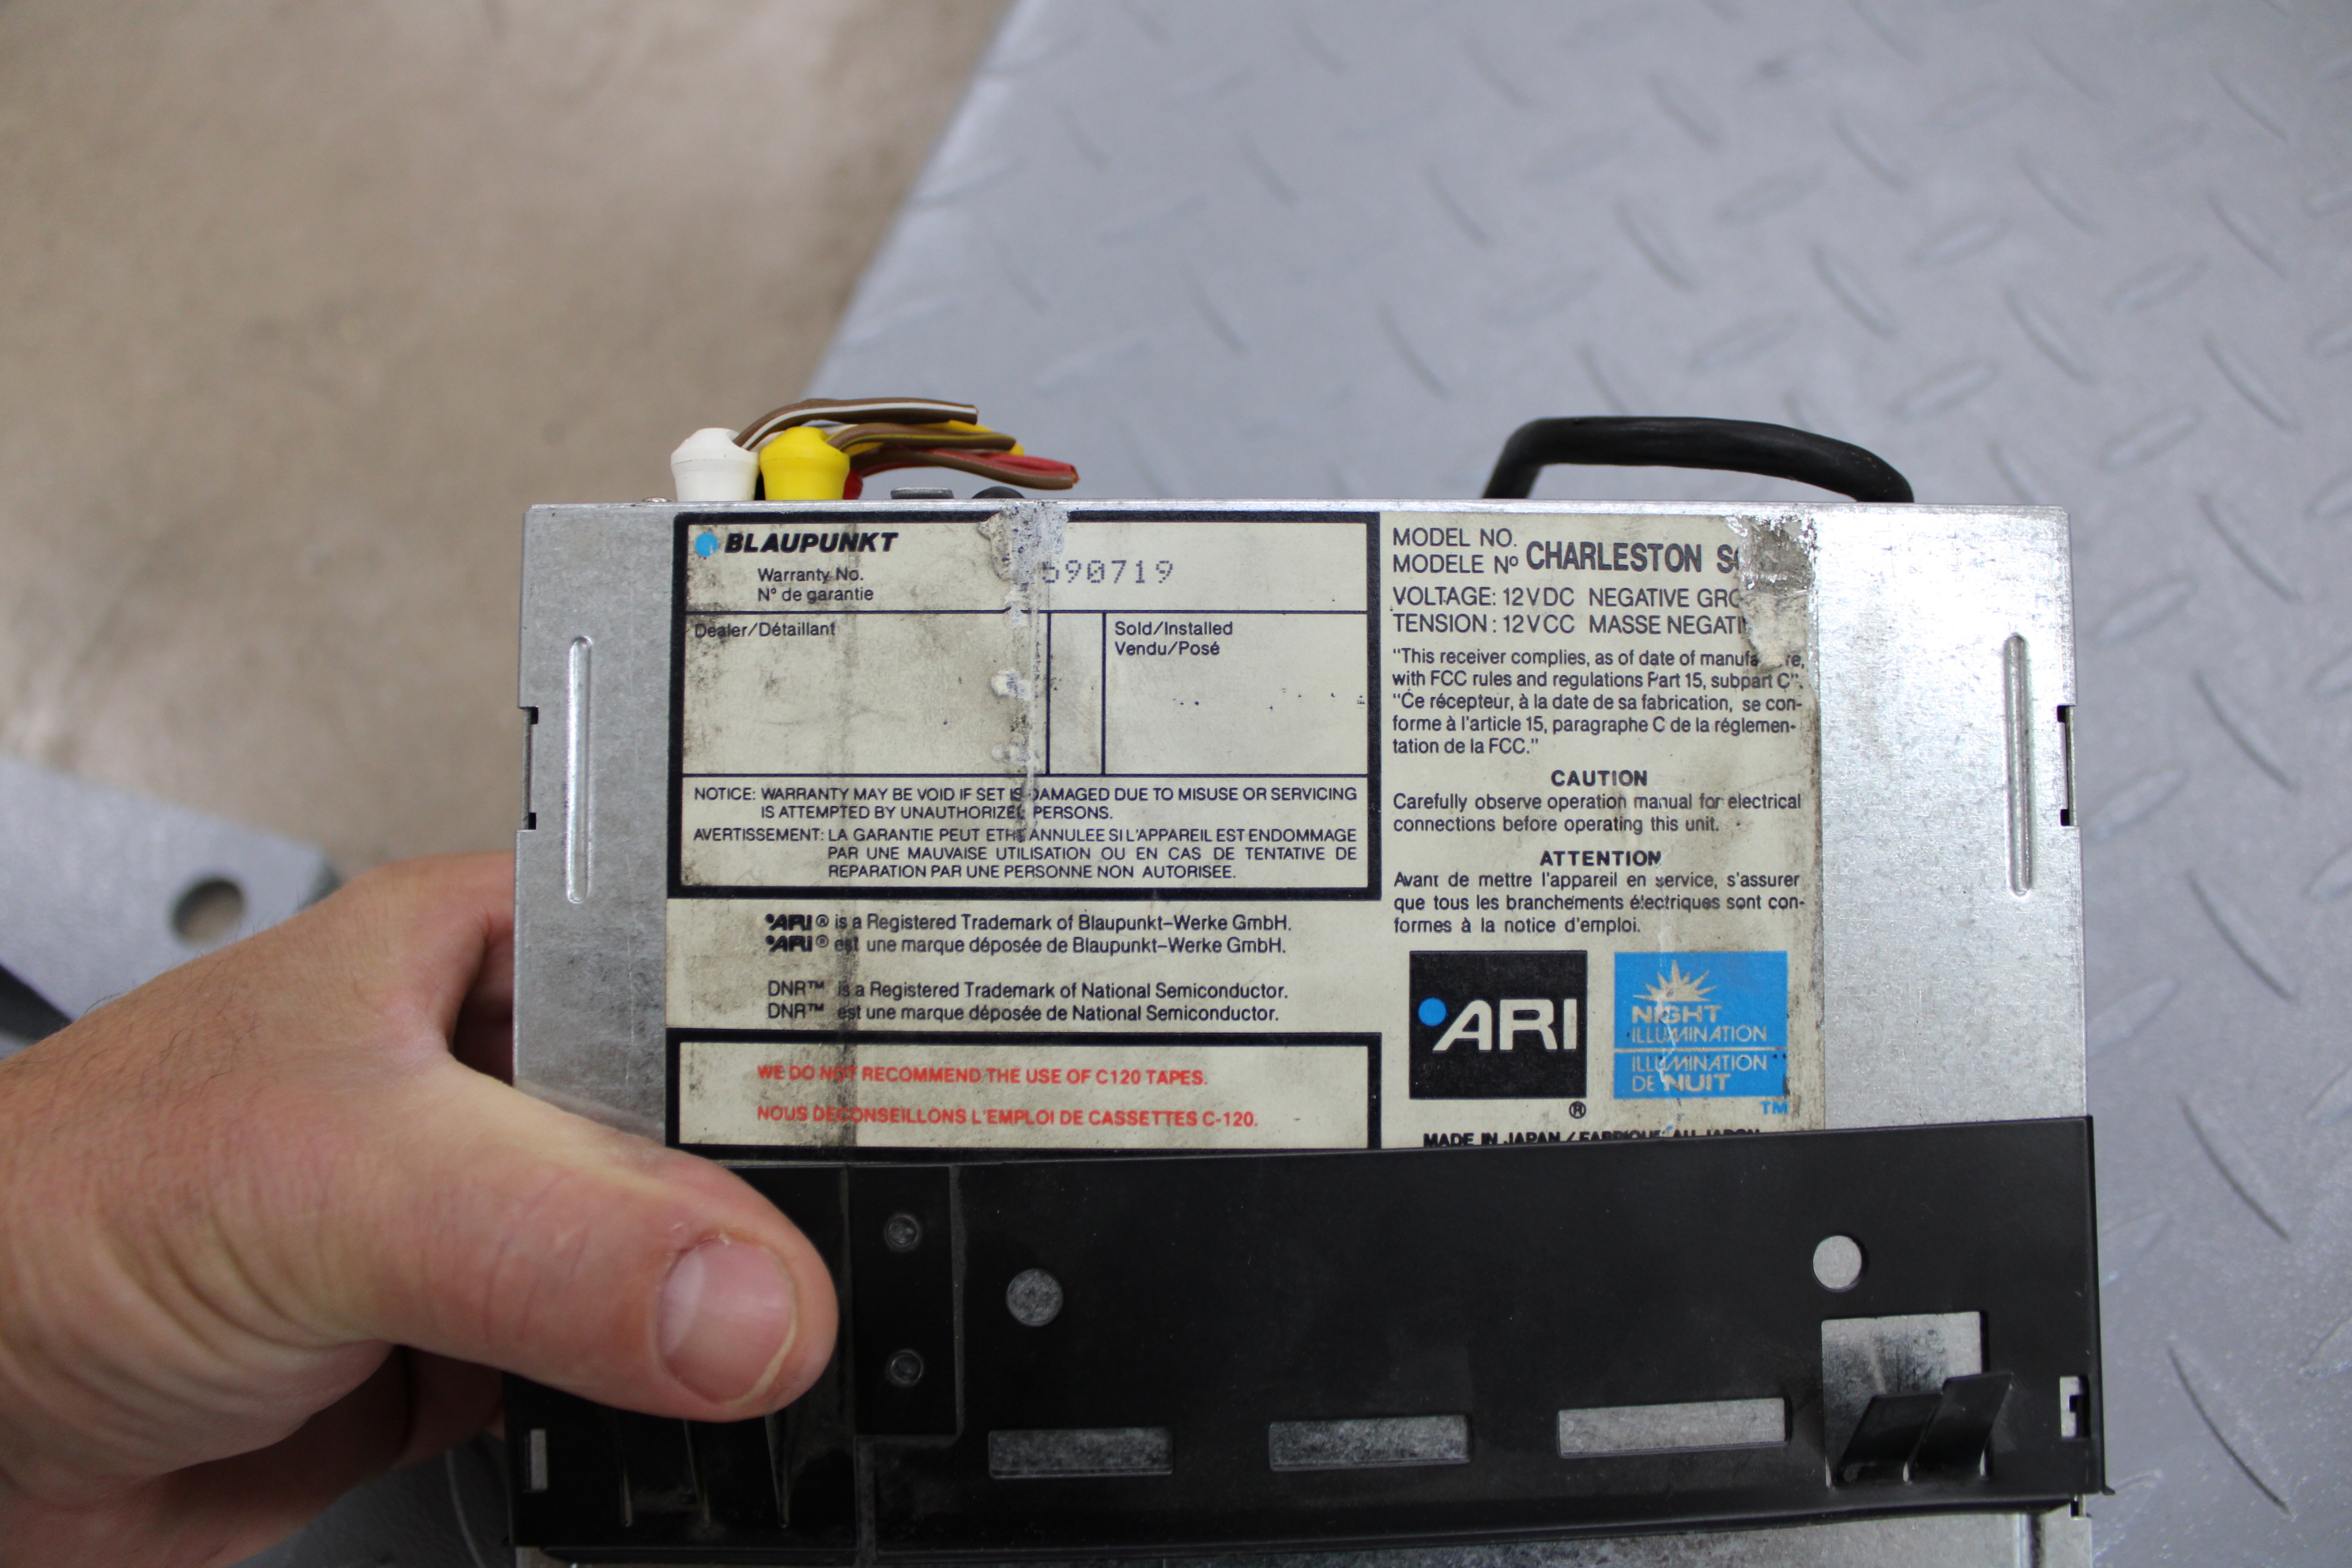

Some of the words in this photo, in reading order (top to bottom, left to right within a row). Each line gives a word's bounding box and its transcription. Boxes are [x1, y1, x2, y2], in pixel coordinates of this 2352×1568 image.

[725, 533, 899, 553] BLAUPUNKT
[1393, 527, 1471, 547] MODEL
[1480, 528, 1517, 548] NO.
[1393, 554, 1484, 573] MODELE
[1526, 541, 1702, 573] CHARLESTON
[757, 568, 830, 583] Warranty
[835, 567, 864, 581] No.
[782, 588, 802, 601] de
[807, 588, 874, 603] garantie
[1393, 586, 1496, 605] VOLTAGE:
[1589, 588, 1690, 607] NEGATIVE
[695, 622, 836, 637] Dealer/Détaillant
[1115, 621, 1233, 635] Sold/Installed
[1115, 641, 1220, 656] Vendu/Posé
[1441, 649, 1506, 664] receiver
[1511, 650, 1590, 667] complies,
[1595, 653, 1614, 665] as
[1619, 650, 1634, 665] of
[1639, 650, 1675, 665] date
[1679, 650, 1696, 666] of
[1393, 671, 1426, 686] with
[1431, 671, 1468, 687] FCC
[1473, 672, 1513, 687] rules
[1517, 672, 1547, 687] and
[1553, 672, 1644, 691] regulations
[1648, 672, 1681, 688] Part
[1686, 672, 1706, 690] 15,
[1711, 673, 1773, 692] subpart
[1430, 693, 1514, 712] récepteur,
[1519, 694, 1529, 709] à
[1534, 694, 1548, 709] la
[1552, 695, 1589, 710] date
[1593, 695, 1615, 710] de
[1619, 697, 1638, 710] sa
[1642, 694, 1733, 712] fabrication,
[1741, 697, 1761, 712] se
[1766, 698, 1803, 712] con-
[1393, 715, 1442, 731] forme
[1446, 716, 1457, 731] à
[1462, 716, 1521, 731] l'article
[1527, 716, 1547, 733] 15,
[1553, 718, 1649, 735] paragraphe
[1653, 716, 1665, 733] C
[1670, 717, 1691, 733] de
[1696, 718, 1710, 733] la
[1715, 718, 1796, 736] réglemen-
[1393, 739, 1439, 754] tation
[1444, 738, 1466, 754] de
[1471, 739, 1485, 754] la
[1551, 770, 1648, 786] CAUTION
[695, 787, 756, 801] NOTICE:
[762, 788, 850, 800] WARRANTY
[854, 789, 888, 800] MAY
[893, 788, 913, 801] BE
[918, 788, 956, 801] VOID
[960, 788, 972, 800] IF
[977, 788, 1005, 801] SET
[1115, 788, 1148, 801] DUE
[1153, 788, 1174, 801] TO
[1178, 787, 1238, 801] MISUSE
[1243, 787, 1267, 801] OR
[1272, 787, 1358, 801] SERVICING
[1393, 793, 1468, 811] Carefully
[1475, 794, 1542, 809] observe
[1547, 793, 1627, 811] operation
[1634, 794, 1692, 809] manual
[1699, 793, 1721, 809] for
[1728, 793, 1801, 809] electrical
[1393, 817, 1496, 831] connections
[1503, 816, 1558, 831] before
[1564, 815, 1643, 835] operating
[1651, 816, 1679, 831] this
[1686, 816, 1719, 831] unit.
[828, 846, 859, 859] PAR
[867, 846, 899, 860] UNE
[908, 846, 987, 860] MAUVAISE
[997, 846, 1091, 860] UTILISATION
[1101, 847, 1126, 860] OU
[1136, 847, 1158, 860] EN
[1169, 847, 1201, 860] CAS
[1214, 847, 1235, 861] DE
[1246, 847, 1325, 860] TENTATIVE
[1336, 846, 1357, 860] DE
[1540, 850, 1661, 866] ATTENTION
[829, 865, 927, 878] REPARATION
[931, 865, 962, 877] PAR
[967, 865, 1000, 878] UNE
[1004, 865, 1092, 878] PERSONNE
[1098, 865, 1134, 878] NON
[1143, 865, 1236, 879] AUTORISEE.
[1394, 898, 1426, 913] que
[1434, 895, 1469, 910] tous
[1477, 895, 1500, 910] les
[1506, 895, 1624, 910] branchements
[1630, 895, 1721, 913] électriques
[1727, 895, 1762, 910] sont
[1768, 897, 1805, 910] con-
[835, 913, 847, 929] is
[851, 917, 862, 929] a
[868, 914, 956, 930] Registered
[962, 914, 1052, 930] Trademark
[1057, 914, 1074, 930] of
[1233, 914, 1292, 930] GmbH.
[1394, 918, 1453, 933] formes
[1461, 918, 1472, 933] à
[1481, 918, 1496, 933] la
[1505, 918, 1556, 933] notice
[1565, 918, 1640, 936] d'emploi.
[854, 986, 865, 997] a
[870, 981, 959, 1001] Registered
[964, 982, 1055, 998] Trademark
[1060, 982, 1077, 998] of
[1082, 982, 1151, 999] National
[1155, 982, 1288, 998] Semiconductor.
[1632, 1006, 1721, 1023] NIGHT
[1432, 999, 1577, 1052] ARI
[1632, 1026, 1767, 1043] ILLUMINATION
[1632, 1055, 1767, 1072] ILLUMINATION
[758, 1065, 785, 1080] WE
[789, 1065, 816, 1080] DO
[820, 1065, 858, 1080] NOT
[861, 1066, 981, 1082] RECOMMEND
[987, 1067, 1021, 1083] THE
[1027, 1069, 1061, 1084] USE
[1066, 1069, 1092, 1084] OF
[1095, 1069, 1142, 1085] C120
[1145, 1069, 1208, 1086] TAPES.
[1632, 1076, 1655, 1092] DE
[1663, 1075, 1730, 1091] NUIT
[758, 1105, 808, 1121] NOUS
[813, 1106, 967, 1125] DECONSEILLONS
[971, 1109, 1055, 1125] L'EMPLOI
[1060, 1110, 1084, 1125] DE
[1089, 1110, 1198, 1126] CASSETTES
[1202, 1111, 1258, 1127] C-120.
[1424, 1133, 1474, 1148] MADE
[1481, 1133, 1498, 1145] IN
[1504, 1132, 1561, 1144] JAPAN
